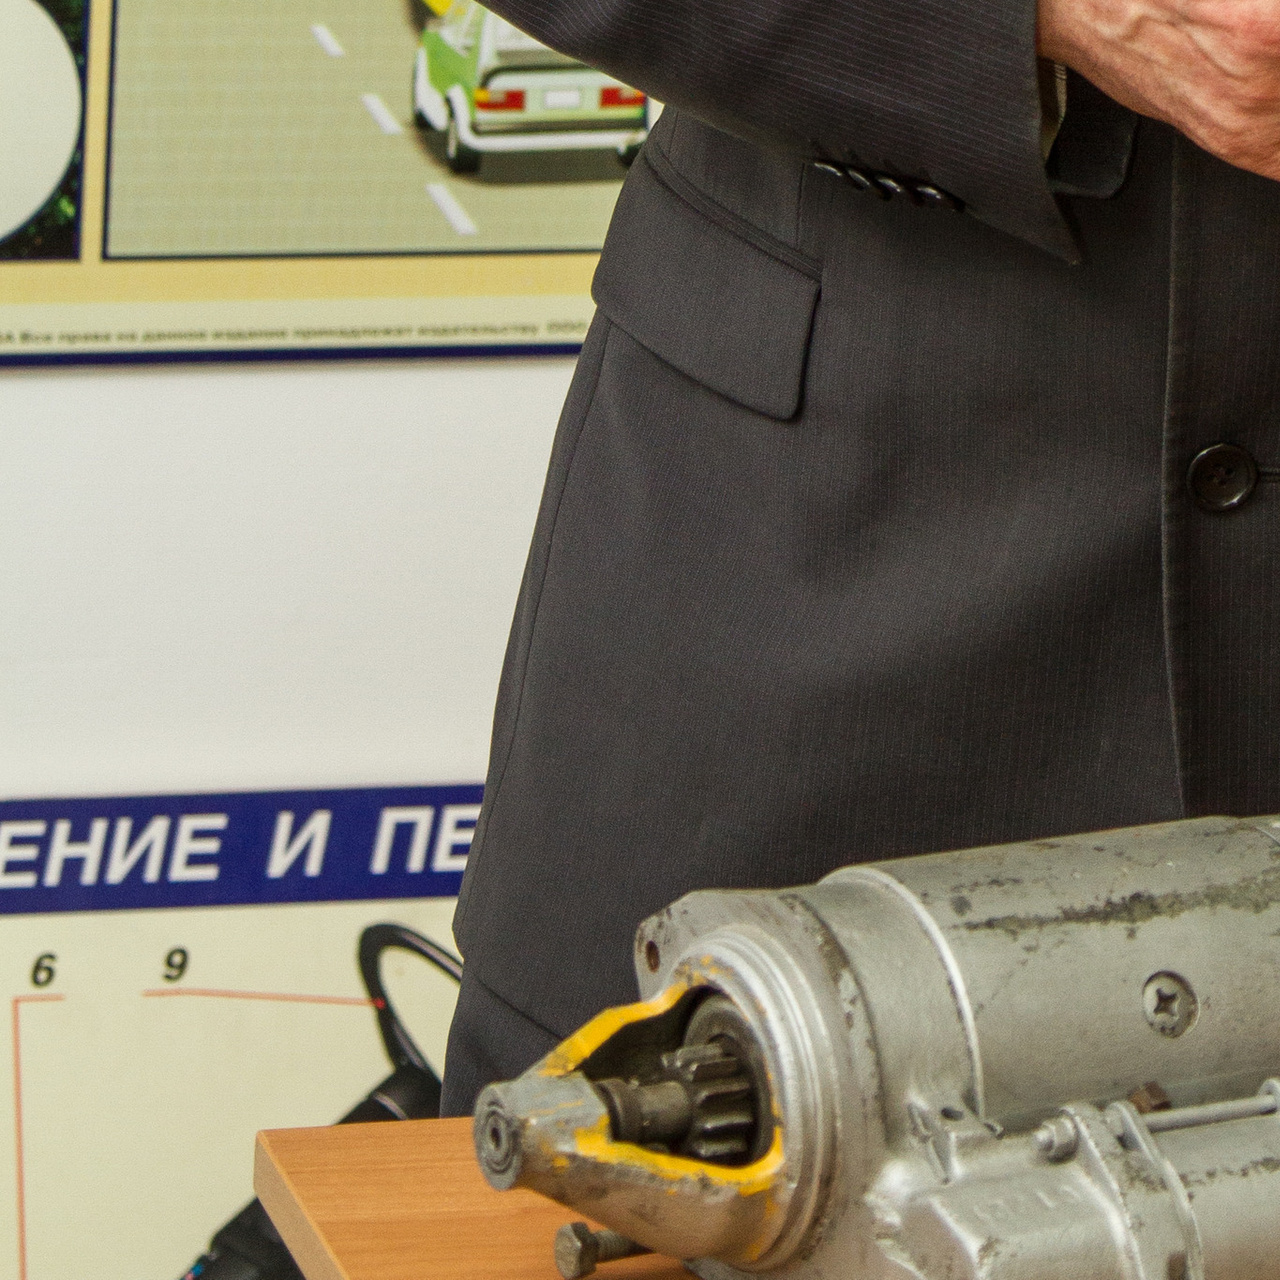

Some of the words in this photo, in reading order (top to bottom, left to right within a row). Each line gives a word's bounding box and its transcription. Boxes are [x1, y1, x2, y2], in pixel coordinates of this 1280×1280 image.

[266, 810, 332, 879] И
[30, 952, 58, 987] 6
[162, 946, 190, 981] 9
